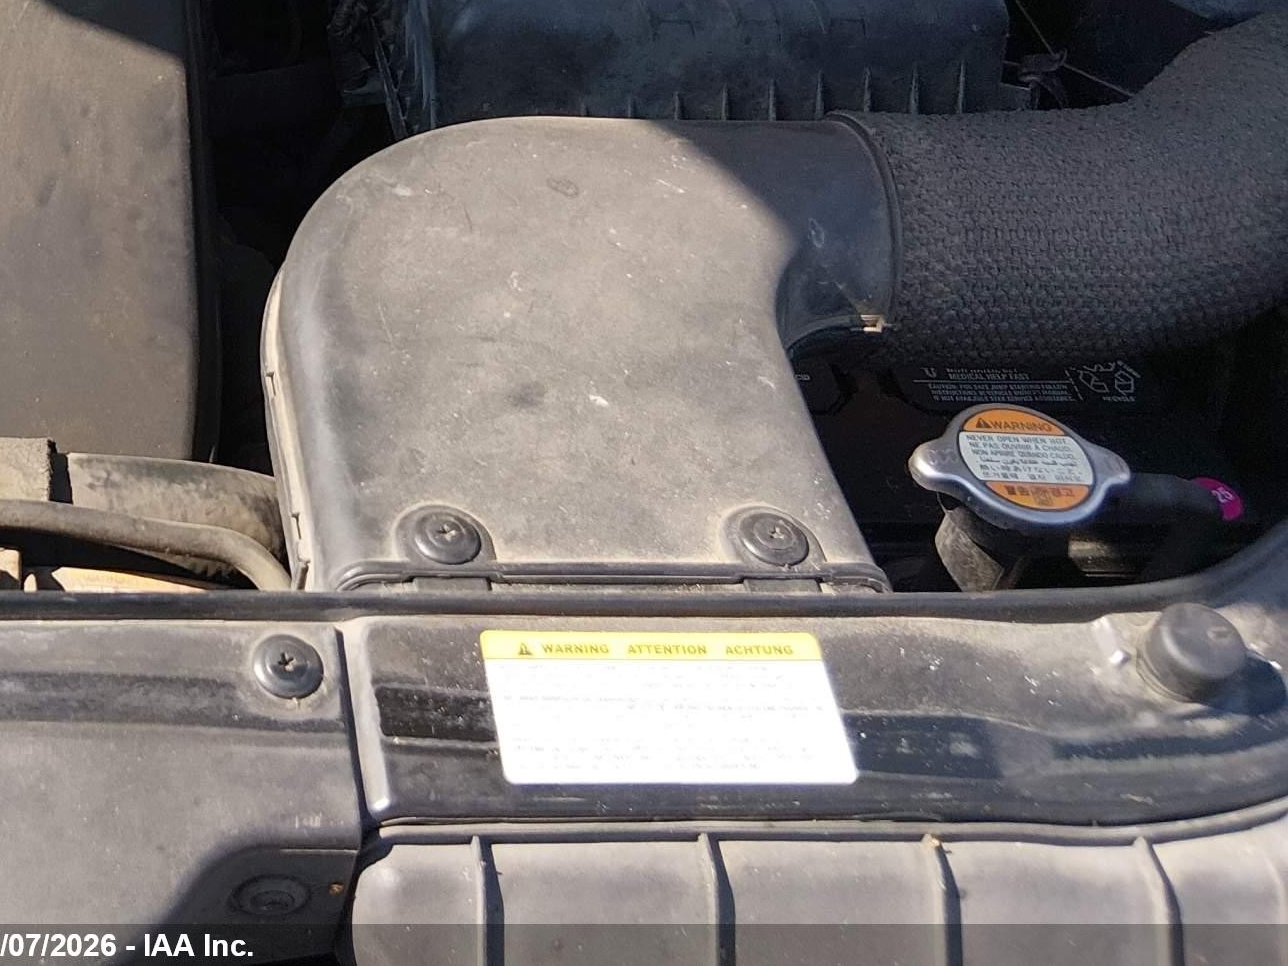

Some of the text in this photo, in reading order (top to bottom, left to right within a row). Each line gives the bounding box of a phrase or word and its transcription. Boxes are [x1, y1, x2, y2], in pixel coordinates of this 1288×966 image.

[992, 422, 1053, 432] WARNING
[1023, 436, 1047, 444] WHEN
[1211, 487, 1233, 504] 25
[541, 643, 795, 656] WARNING ATTENTION ACHTUNG
